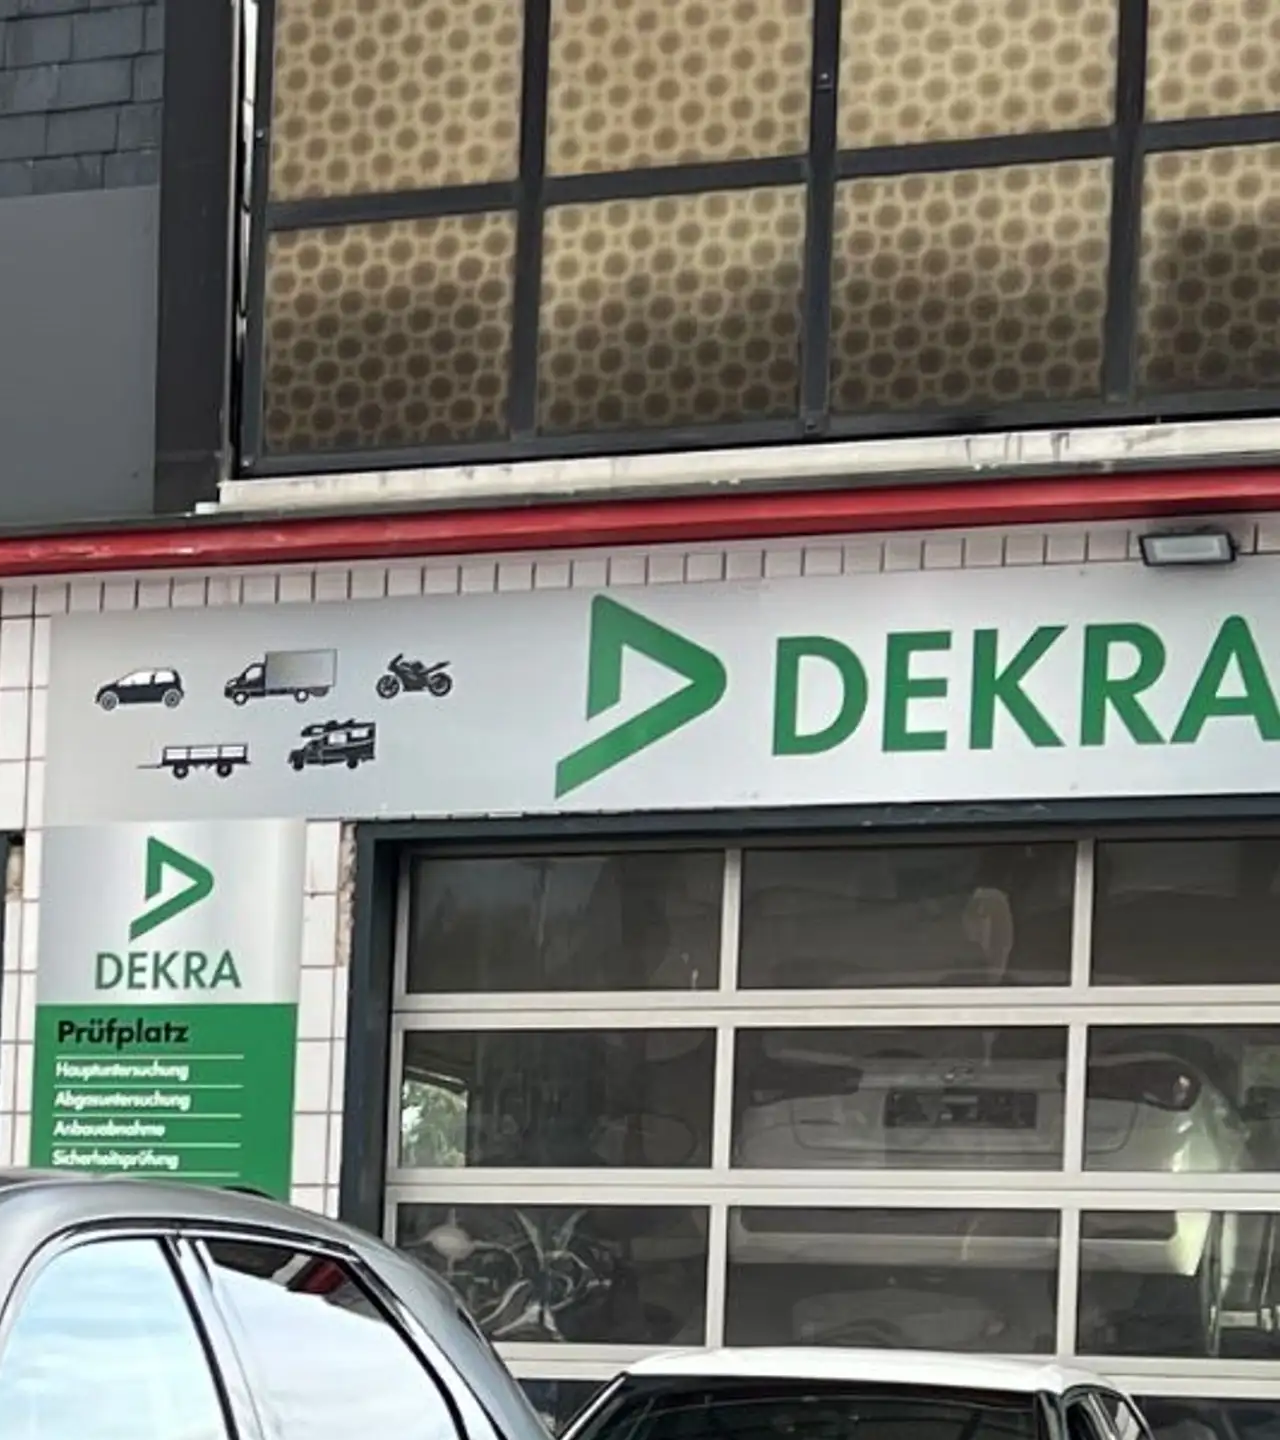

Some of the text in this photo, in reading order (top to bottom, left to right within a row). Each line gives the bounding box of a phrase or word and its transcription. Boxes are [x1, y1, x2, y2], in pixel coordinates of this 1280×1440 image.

[772, 615, 1280, 756] DEKRA
[95, 950, 242, 989] DEKRA
[58, 1018, 189, 1049] Prüfplatz
[55, 1060, 190, 1081] Hauptuntersuchung
